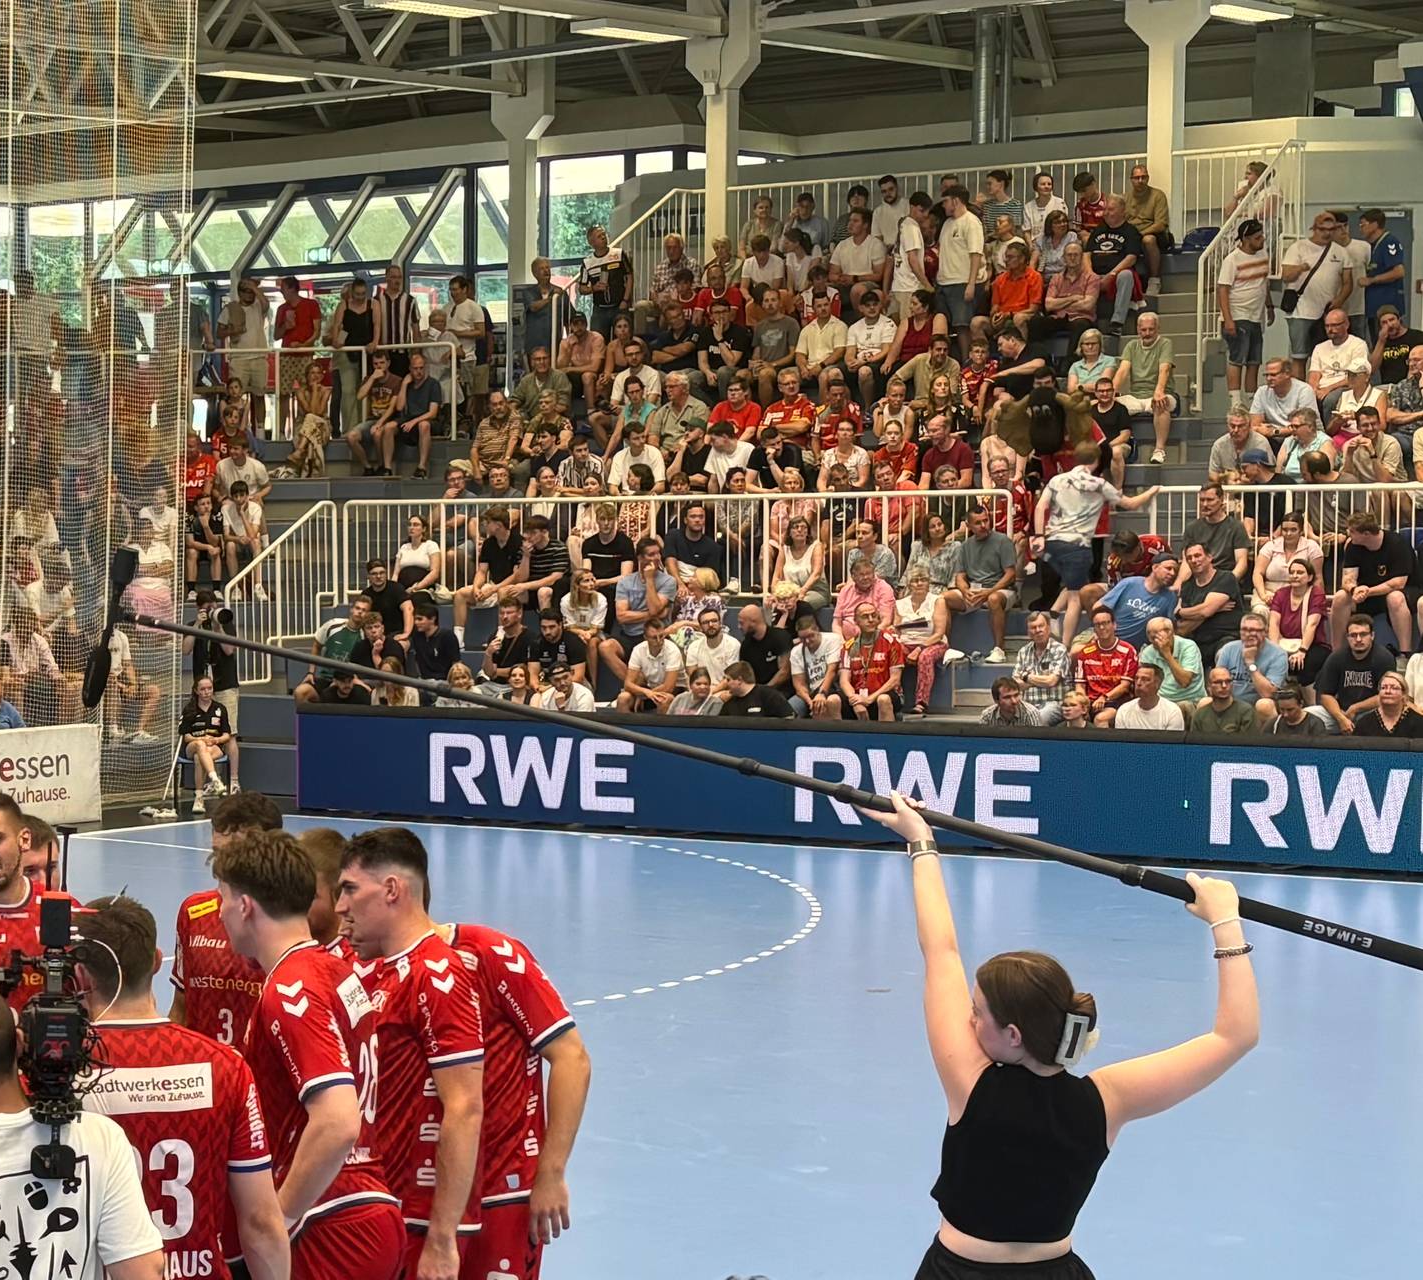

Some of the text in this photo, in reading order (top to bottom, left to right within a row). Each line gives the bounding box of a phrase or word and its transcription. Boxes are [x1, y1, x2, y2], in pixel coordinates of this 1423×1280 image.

[429, 732, 635, 813] RWE
[794, 746, 1040, 836] RWE
[1209, 761, 1423, 854] RW
[1302, 919, 1374, 949] E-IMAGE
[164, 1249, 214, 1280] AUS
